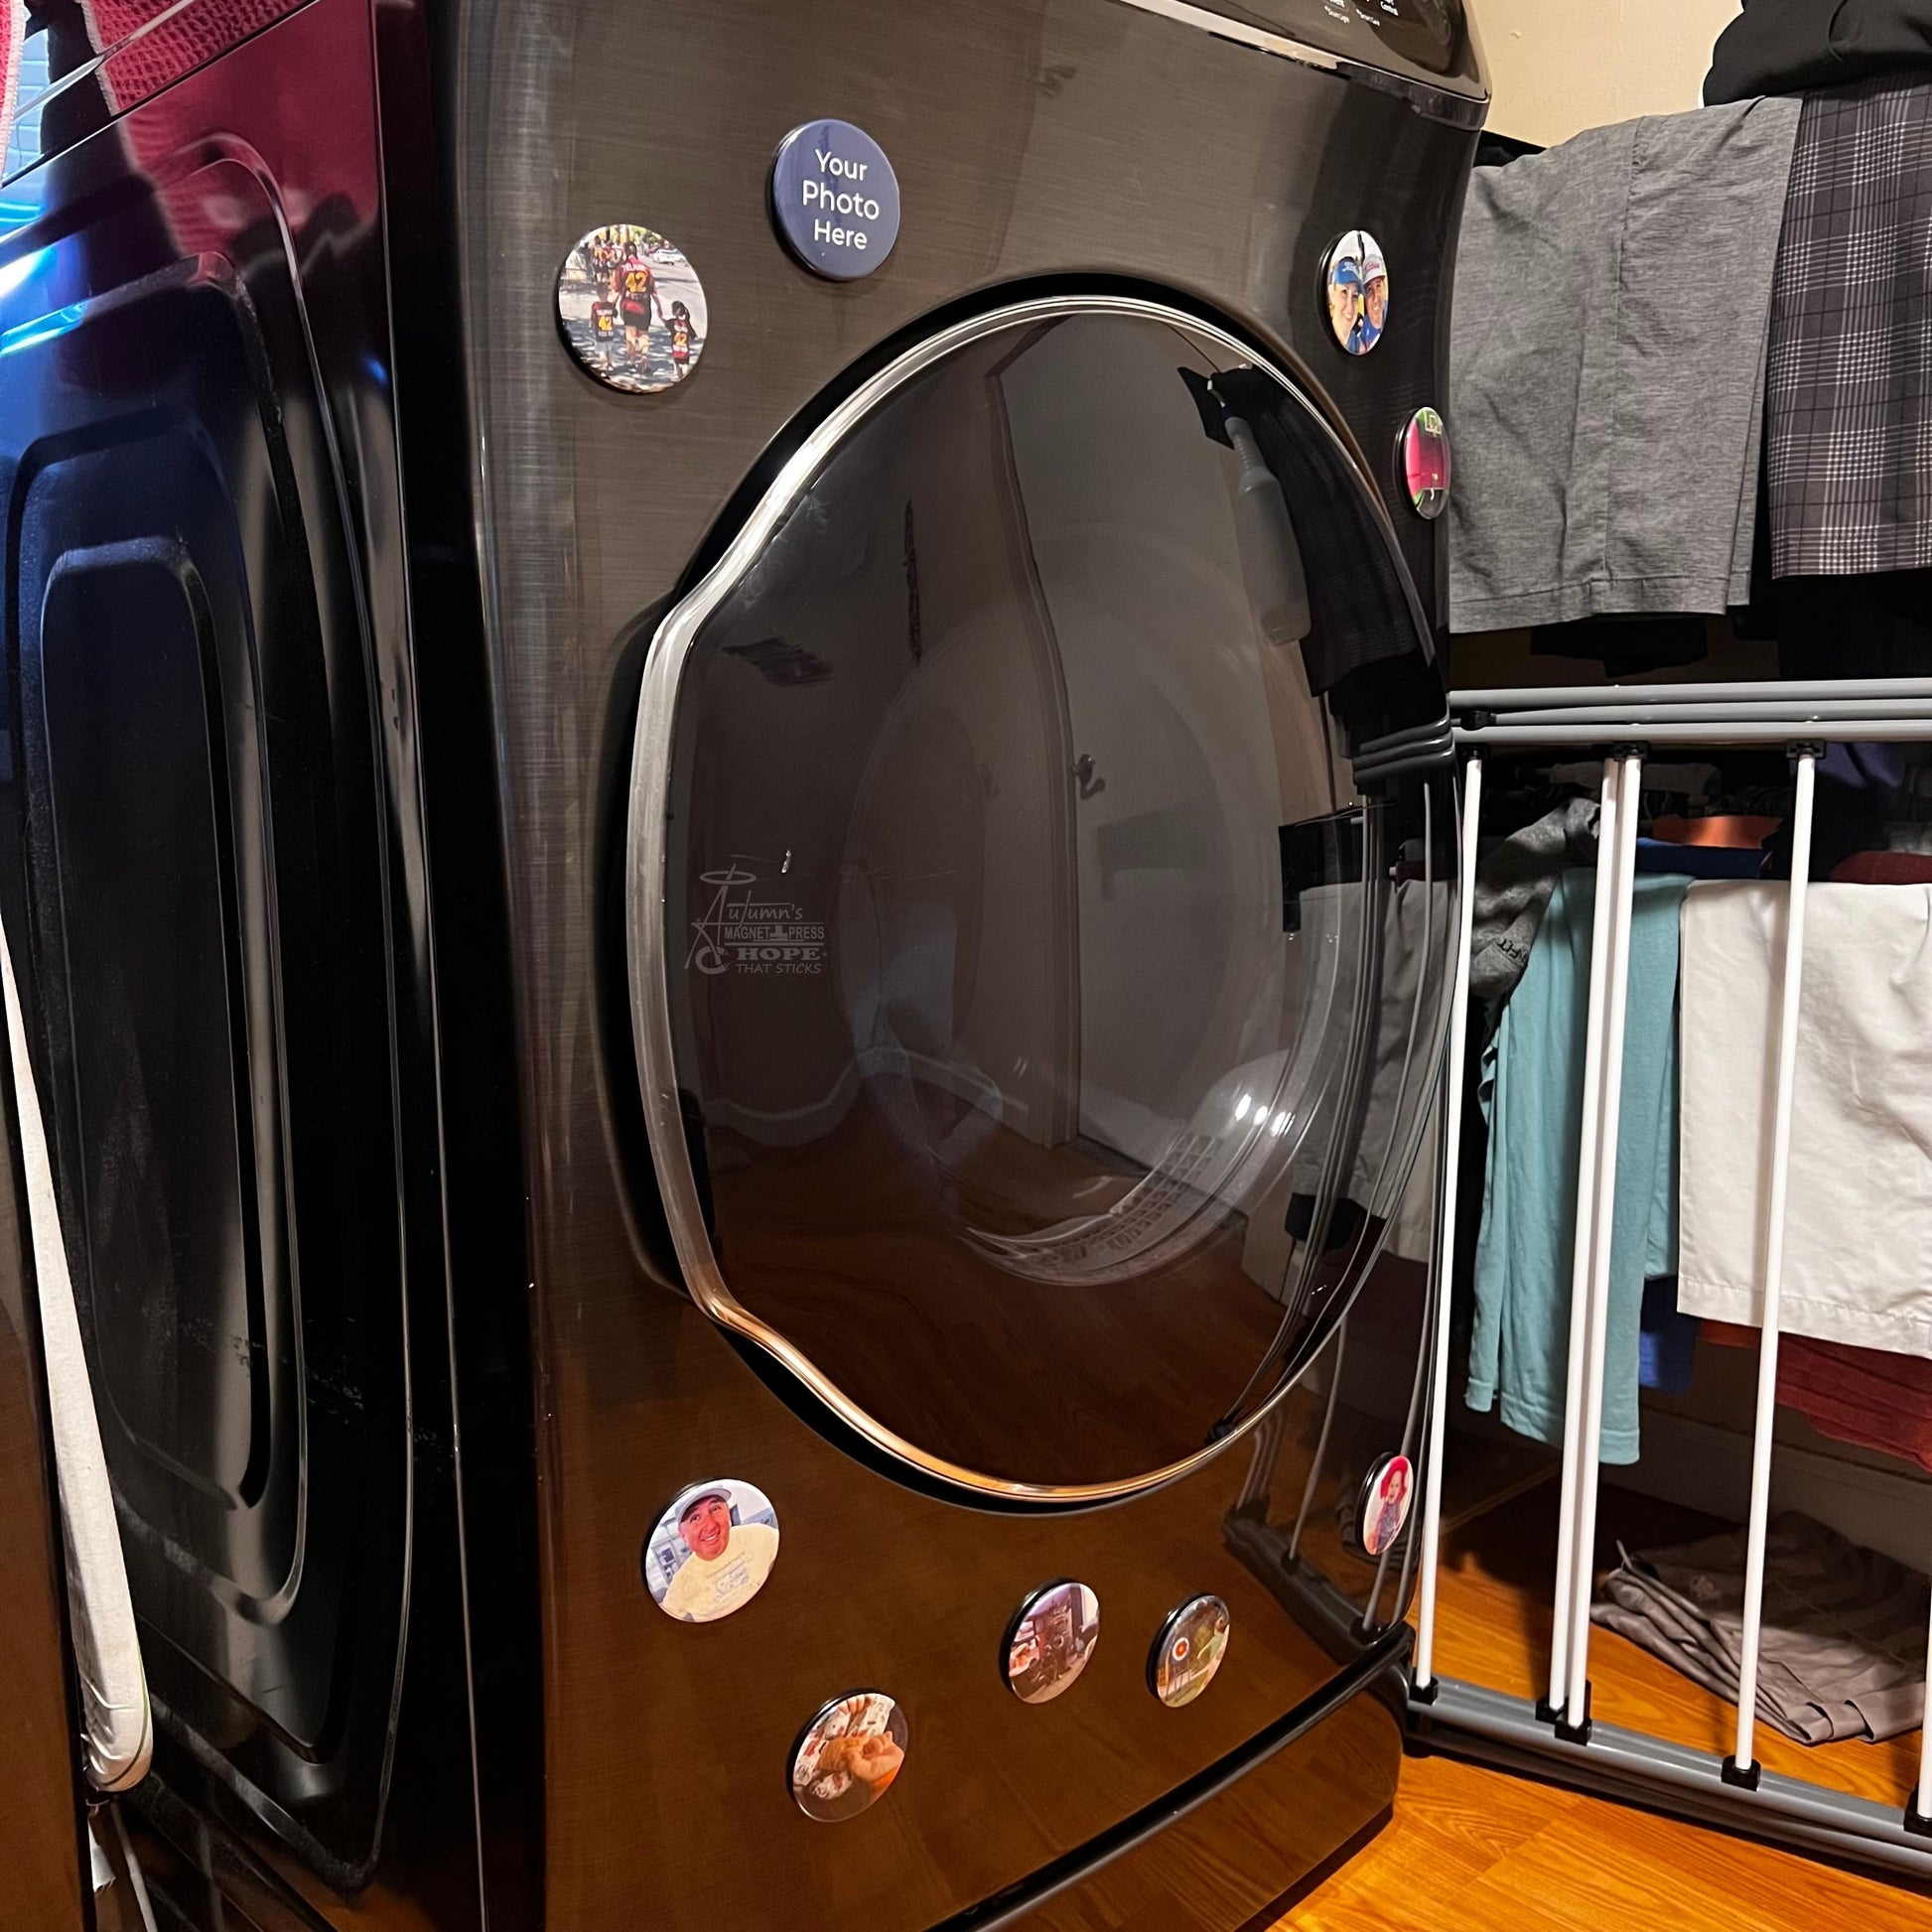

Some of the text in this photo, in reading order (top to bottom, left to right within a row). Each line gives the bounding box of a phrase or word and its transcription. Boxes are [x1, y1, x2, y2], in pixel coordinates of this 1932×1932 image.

[815, 149, 868, 181] Your
[803, 180, 879, 220] Photo
[814, 218, 868, 250] Here
[624, 272, 646, 293] 42
[598, 316, 613, 331] 42
